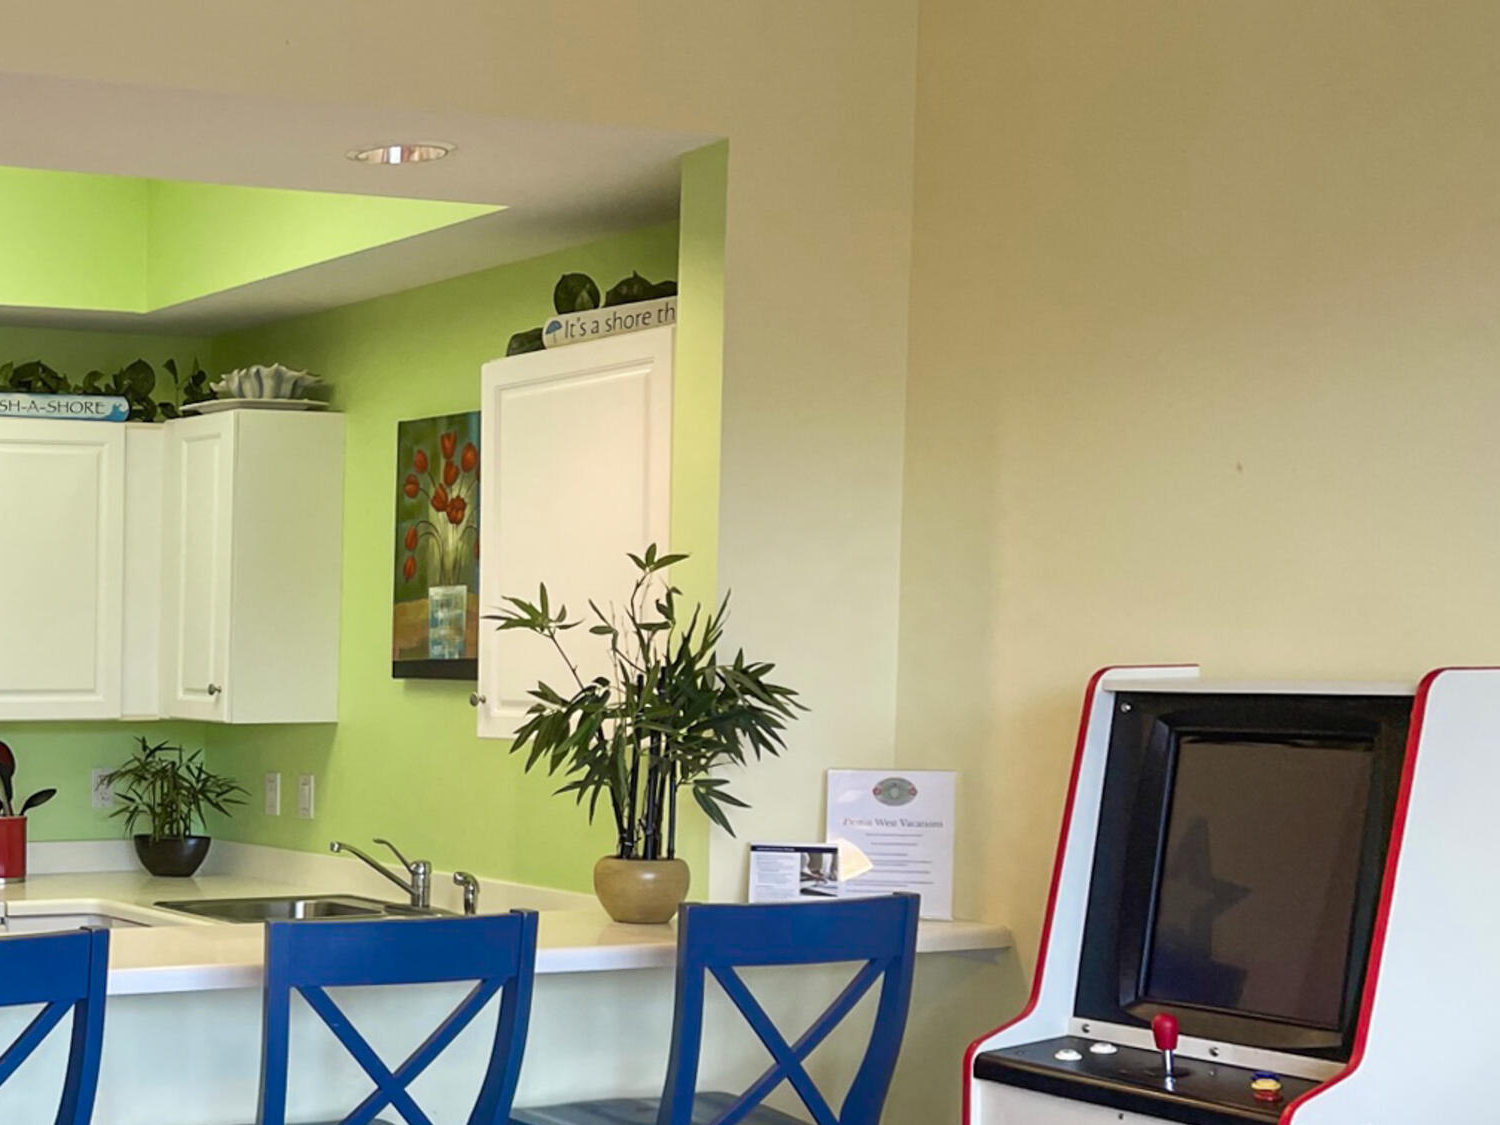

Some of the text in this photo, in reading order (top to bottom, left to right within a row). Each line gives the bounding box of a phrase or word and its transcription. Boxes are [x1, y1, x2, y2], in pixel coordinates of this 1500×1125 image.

[564, 317, 587, 339] It's
[590, 320, 600, 335] a
[605, 311, 653, 333] shore
